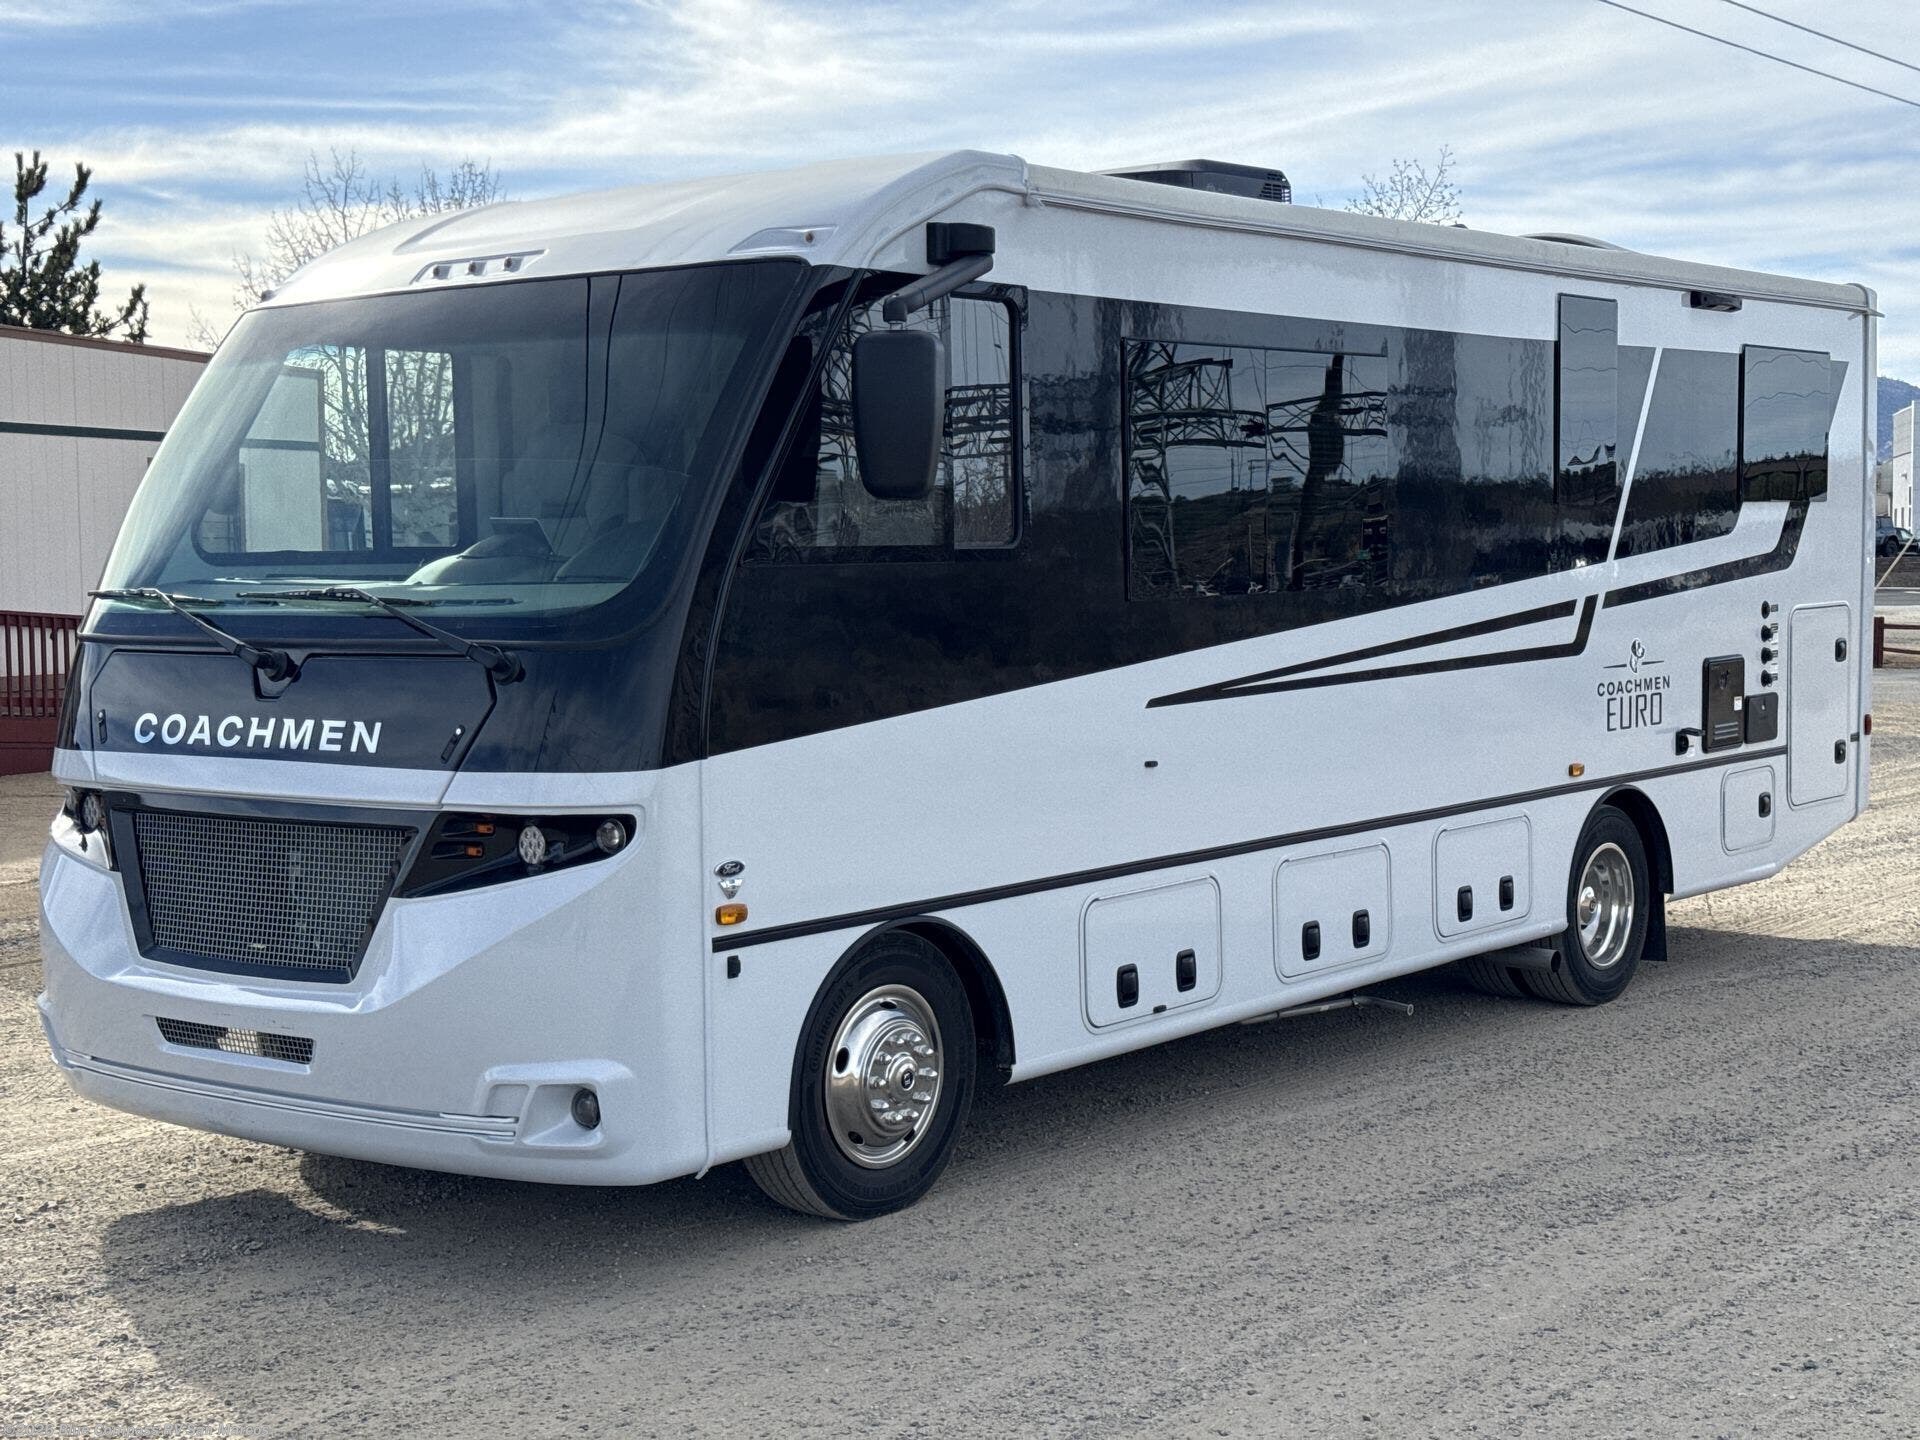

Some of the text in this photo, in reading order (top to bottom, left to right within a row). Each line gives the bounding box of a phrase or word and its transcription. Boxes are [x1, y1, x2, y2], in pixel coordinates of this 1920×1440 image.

[1597, 675, 1671, 697] COACHMEN
[1607, 692, 1662, 732] EURO
[134, 712, 382, 754] COACHMEN
